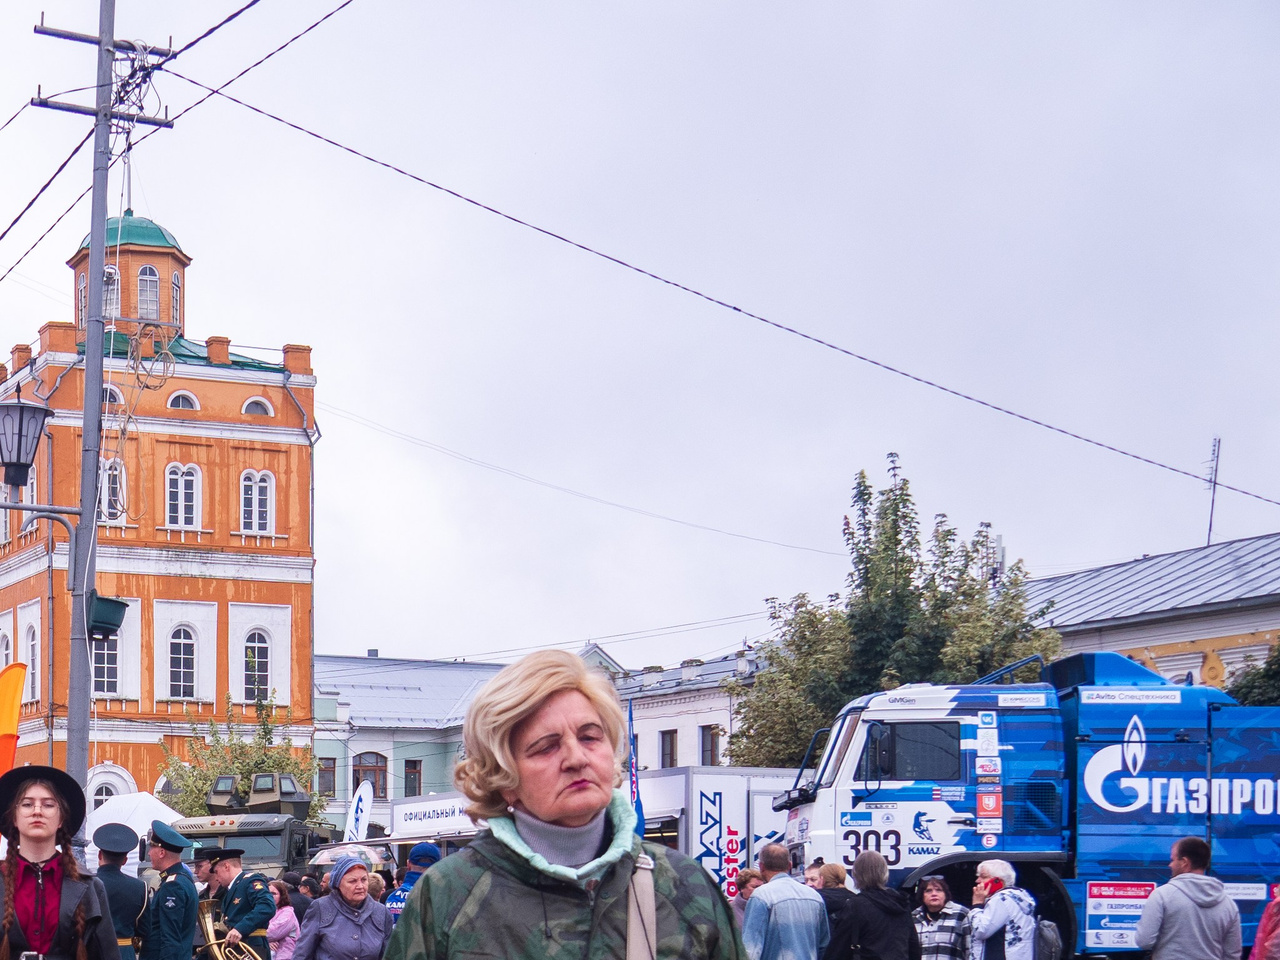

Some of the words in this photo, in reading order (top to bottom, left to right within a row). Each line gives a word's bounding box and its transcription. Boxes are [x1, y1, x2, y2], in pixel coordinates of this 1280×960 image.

[1118, 693, 1177, 701] Спецтехника
[1151, 777, 1280, 815] ГАЗПРО
[403, 806, 456, 822] ОФИЦИАЛЬНЫЙ
[842, 829, 902, 867] 303
[908, 846, 941, 855] KAMAZ
[724, 825, 739, 903] aster
